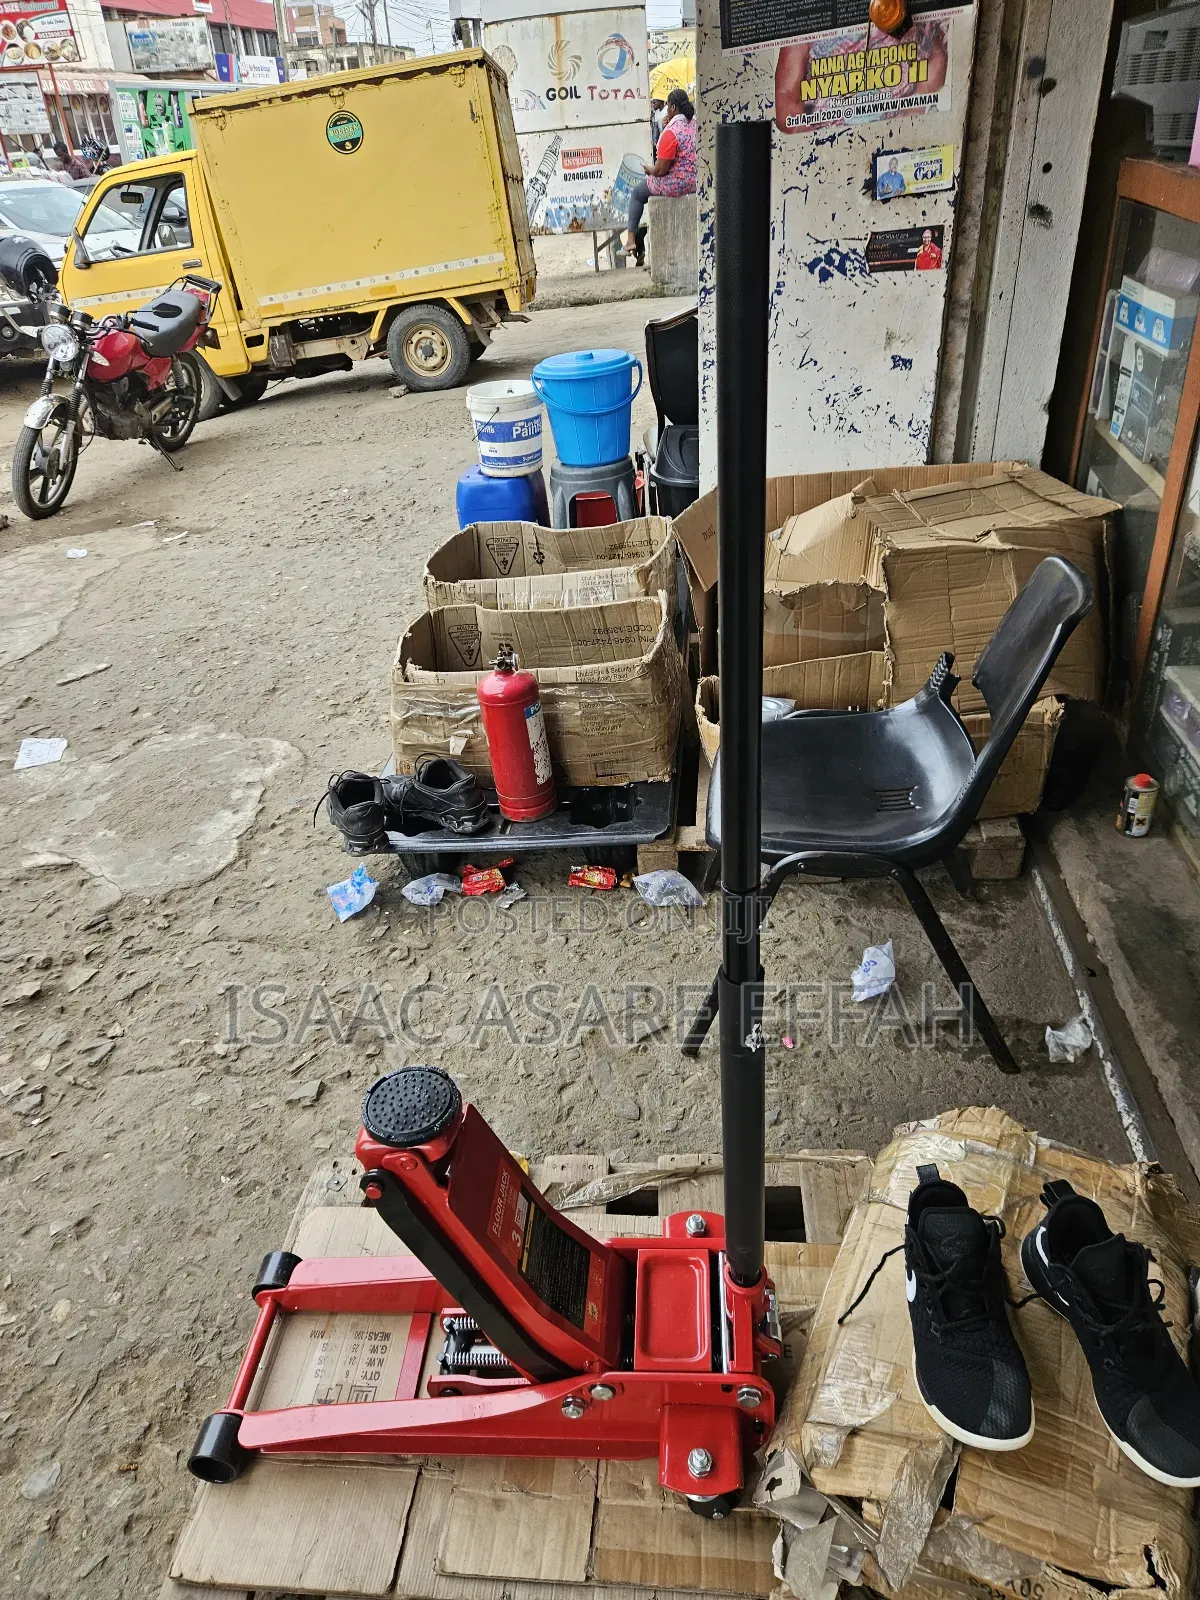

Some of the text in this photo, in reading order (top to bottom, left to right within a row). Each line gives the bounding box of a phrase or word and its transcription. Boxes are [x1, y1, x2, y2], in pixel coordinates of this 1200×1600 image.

[811, 42, 917, 77] NANA AGYAPONG
[800, 60, 928, 101] NYARKO II
[546, 86, 581, 101] GOIL
[828, 91, 891, 108] Kwamanhene
[786, 116, 799, 127] 3rd
[801, 113, 820, 126] April
[822, 109, 841, 121] 2020
[843, 107, 854, 119] @
[592, 625, 653, 635] CODE:135992
[492, 1198, 504, 1235] FLOOR
[499, 1170, 509, 1198] JACK
[511, 1230, 521, 1248] 3
[366, 1358, 384, 1368] N.W:
[361, 1371, 381, 1381] QTY:
